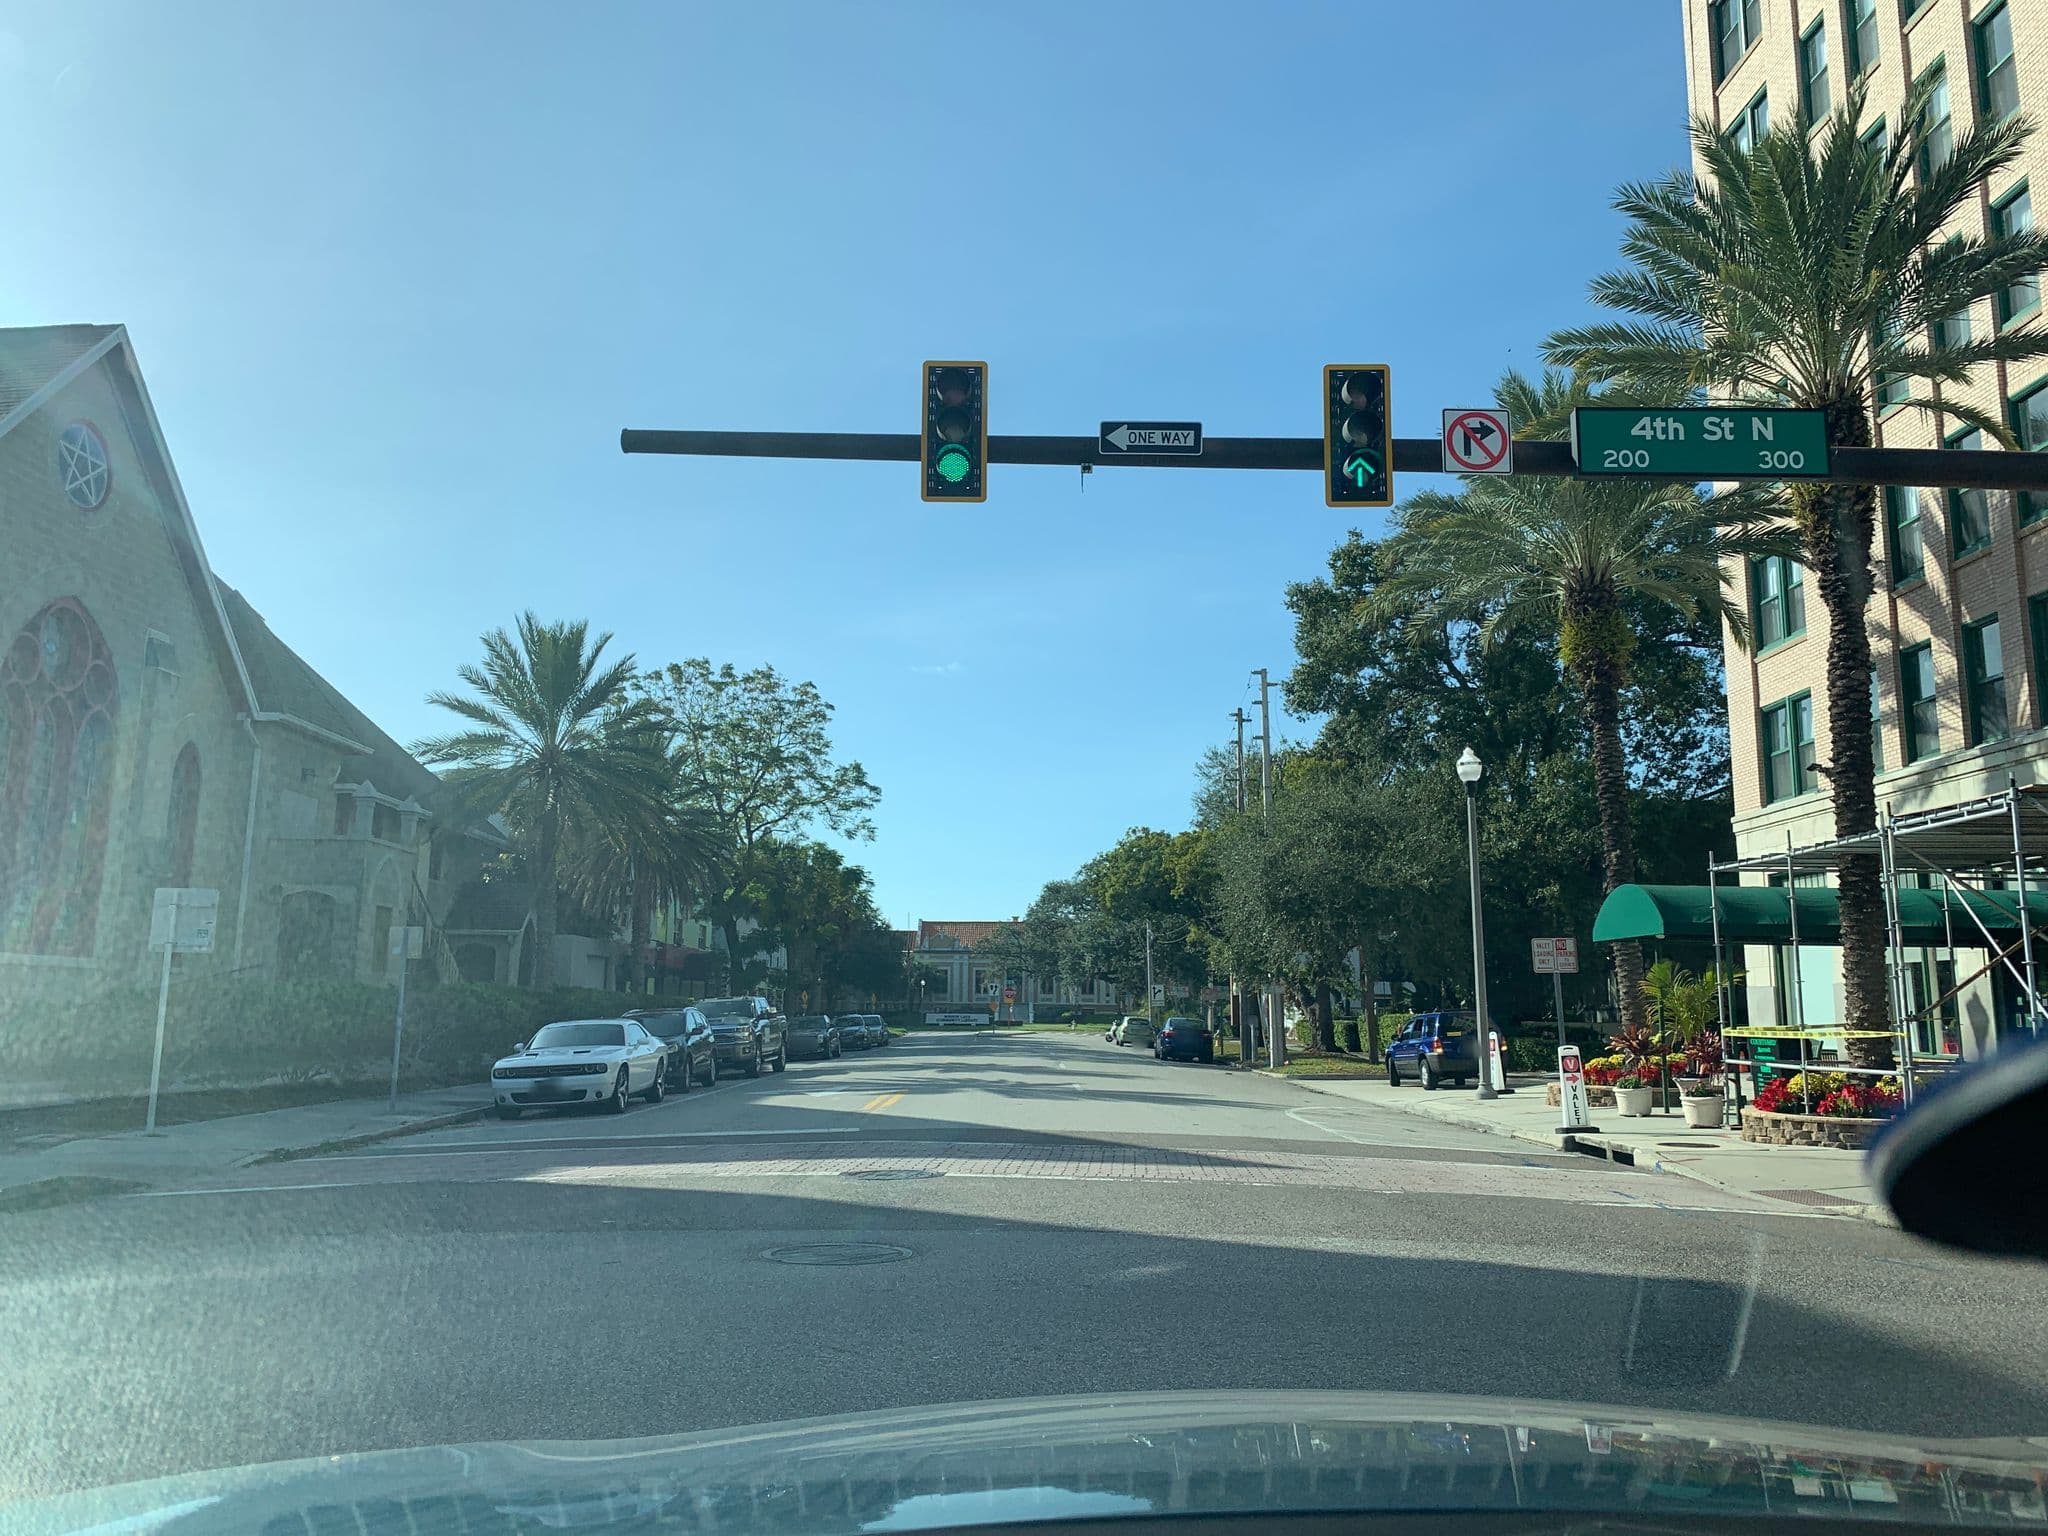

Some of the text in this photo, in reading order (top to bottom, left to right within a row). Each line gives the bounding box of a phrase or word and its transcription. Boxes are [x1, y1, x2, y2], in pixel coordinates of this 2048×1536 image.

[1128, 431, 1190, 445] ONE WAY
[1631, 417, 1774, 441] 4th St N
[1604, 449, 1650, 468] 200
[1758, 451, 1804, 469] 300
[1566, 1059, 1575, 1069] V
[1571, 1085, 1582, 1125] VALET
